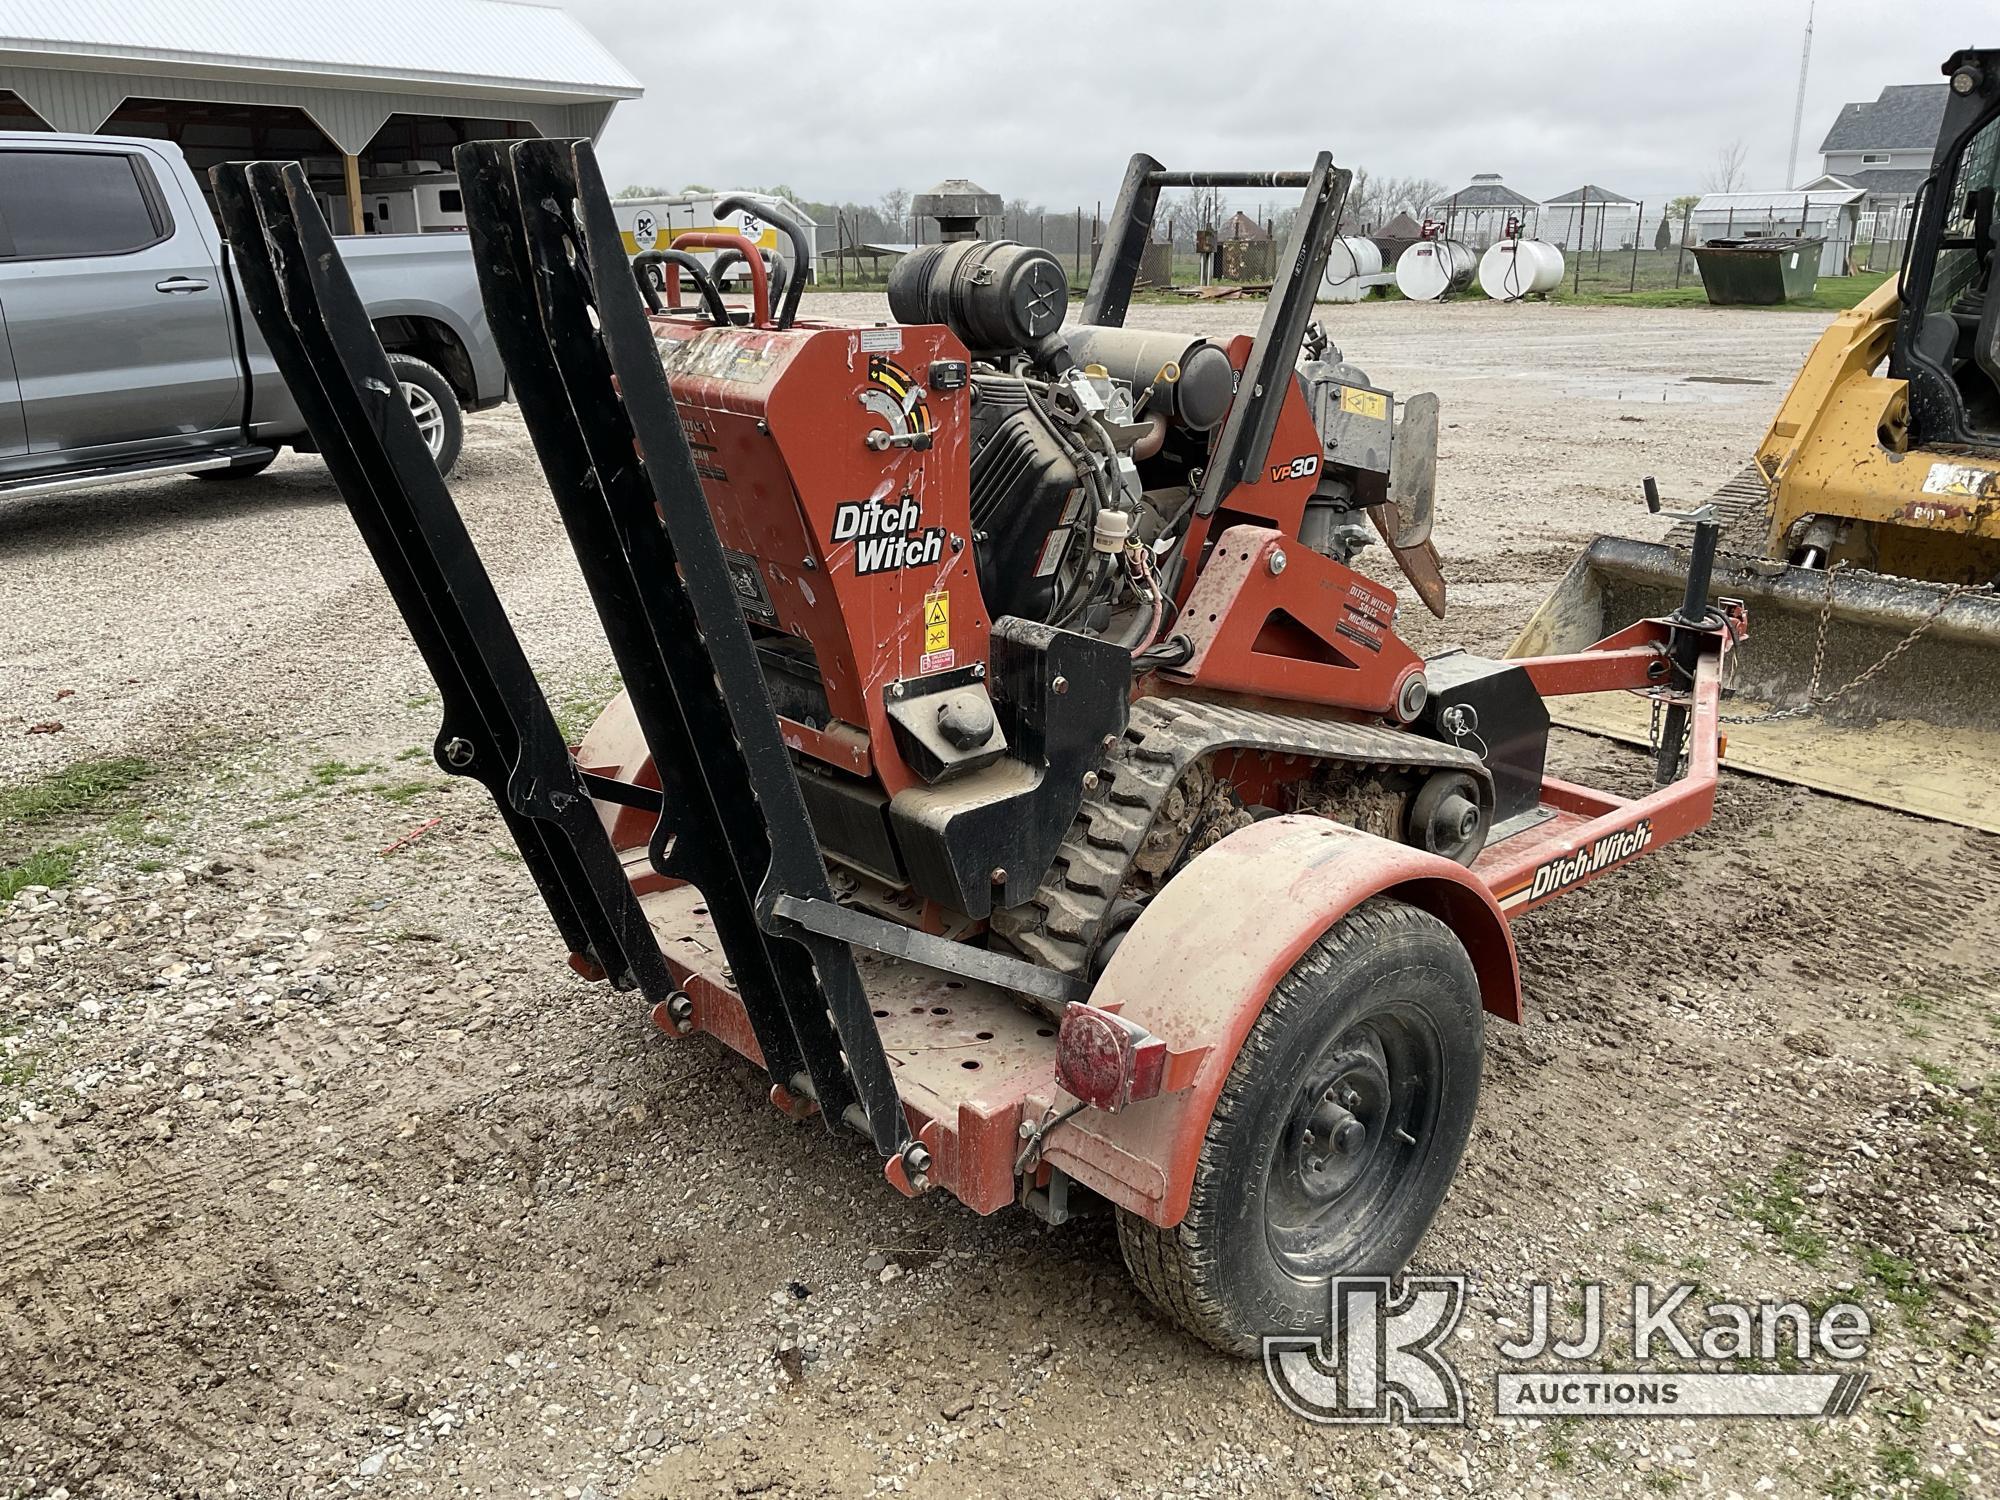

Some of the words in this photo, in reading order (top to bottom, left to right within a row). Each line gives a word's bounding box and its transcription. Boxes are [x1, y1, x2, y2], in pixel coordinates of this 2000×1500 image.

[1272, 456, 1318, 481] VP30
[834, 498, 918, 539] Ditch
[858, 531, 942, 573] Witch
[1350, 586, 1371, 602] DITCH
[1370, 595, 1392, 613] WITCH
[1359, 602, 1379, 618] SALES
[1348, 613, 1379, 634] MICHIGAN
[1530, 849, 1588, 900] Ditch
[1591, 822, 1647, 870] Witch
